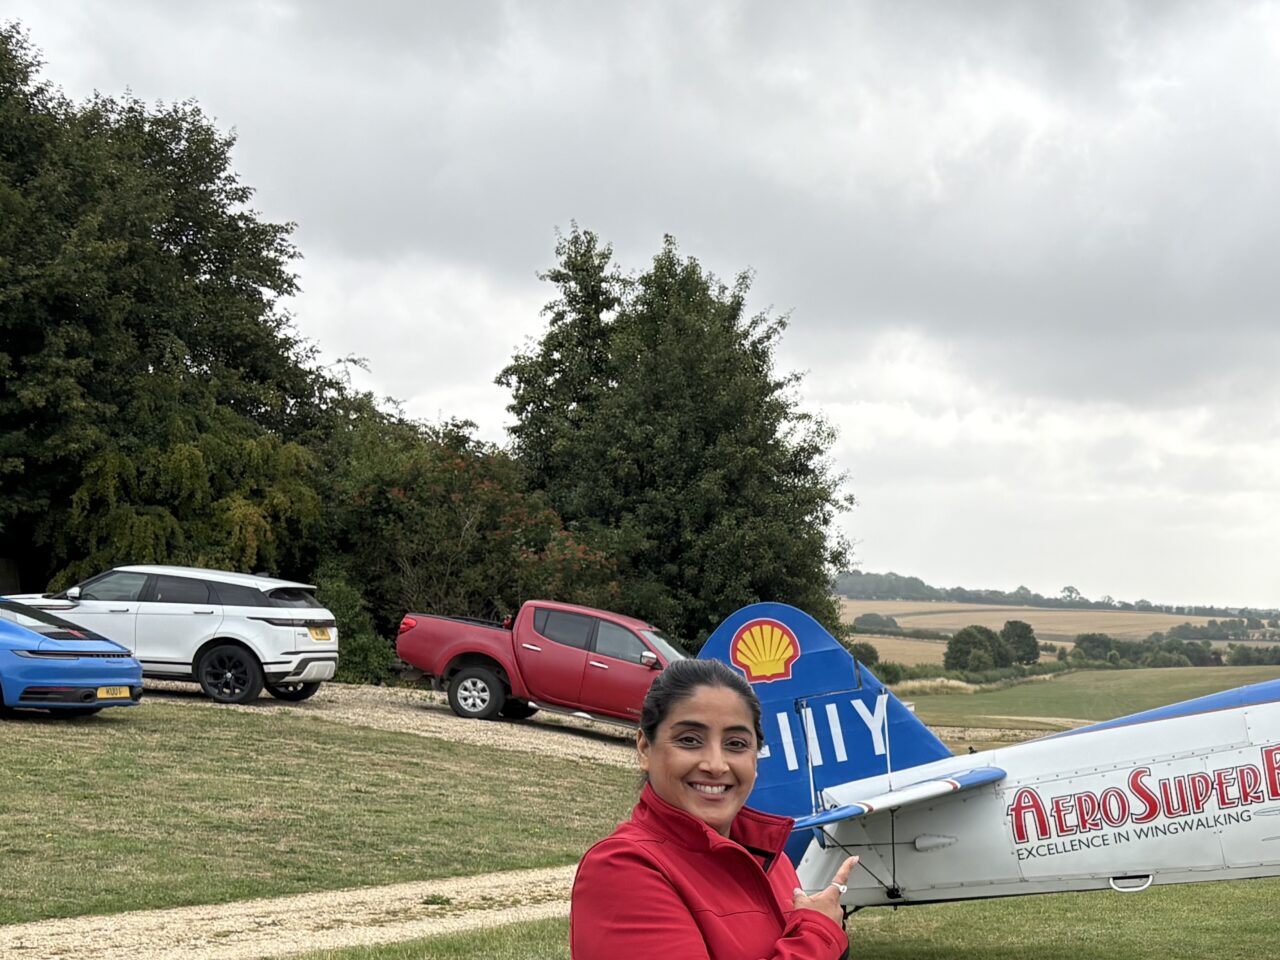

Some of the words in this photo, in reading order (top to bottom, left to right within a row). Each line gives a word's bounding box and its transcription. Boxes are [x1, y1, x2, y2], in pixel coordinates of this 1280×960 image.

[1016, 833, 1110, 861] EXCELLENCE
[1113, 830, 1131, 845] IN
[1133, 809, 1252, 840] WINGWALKING
